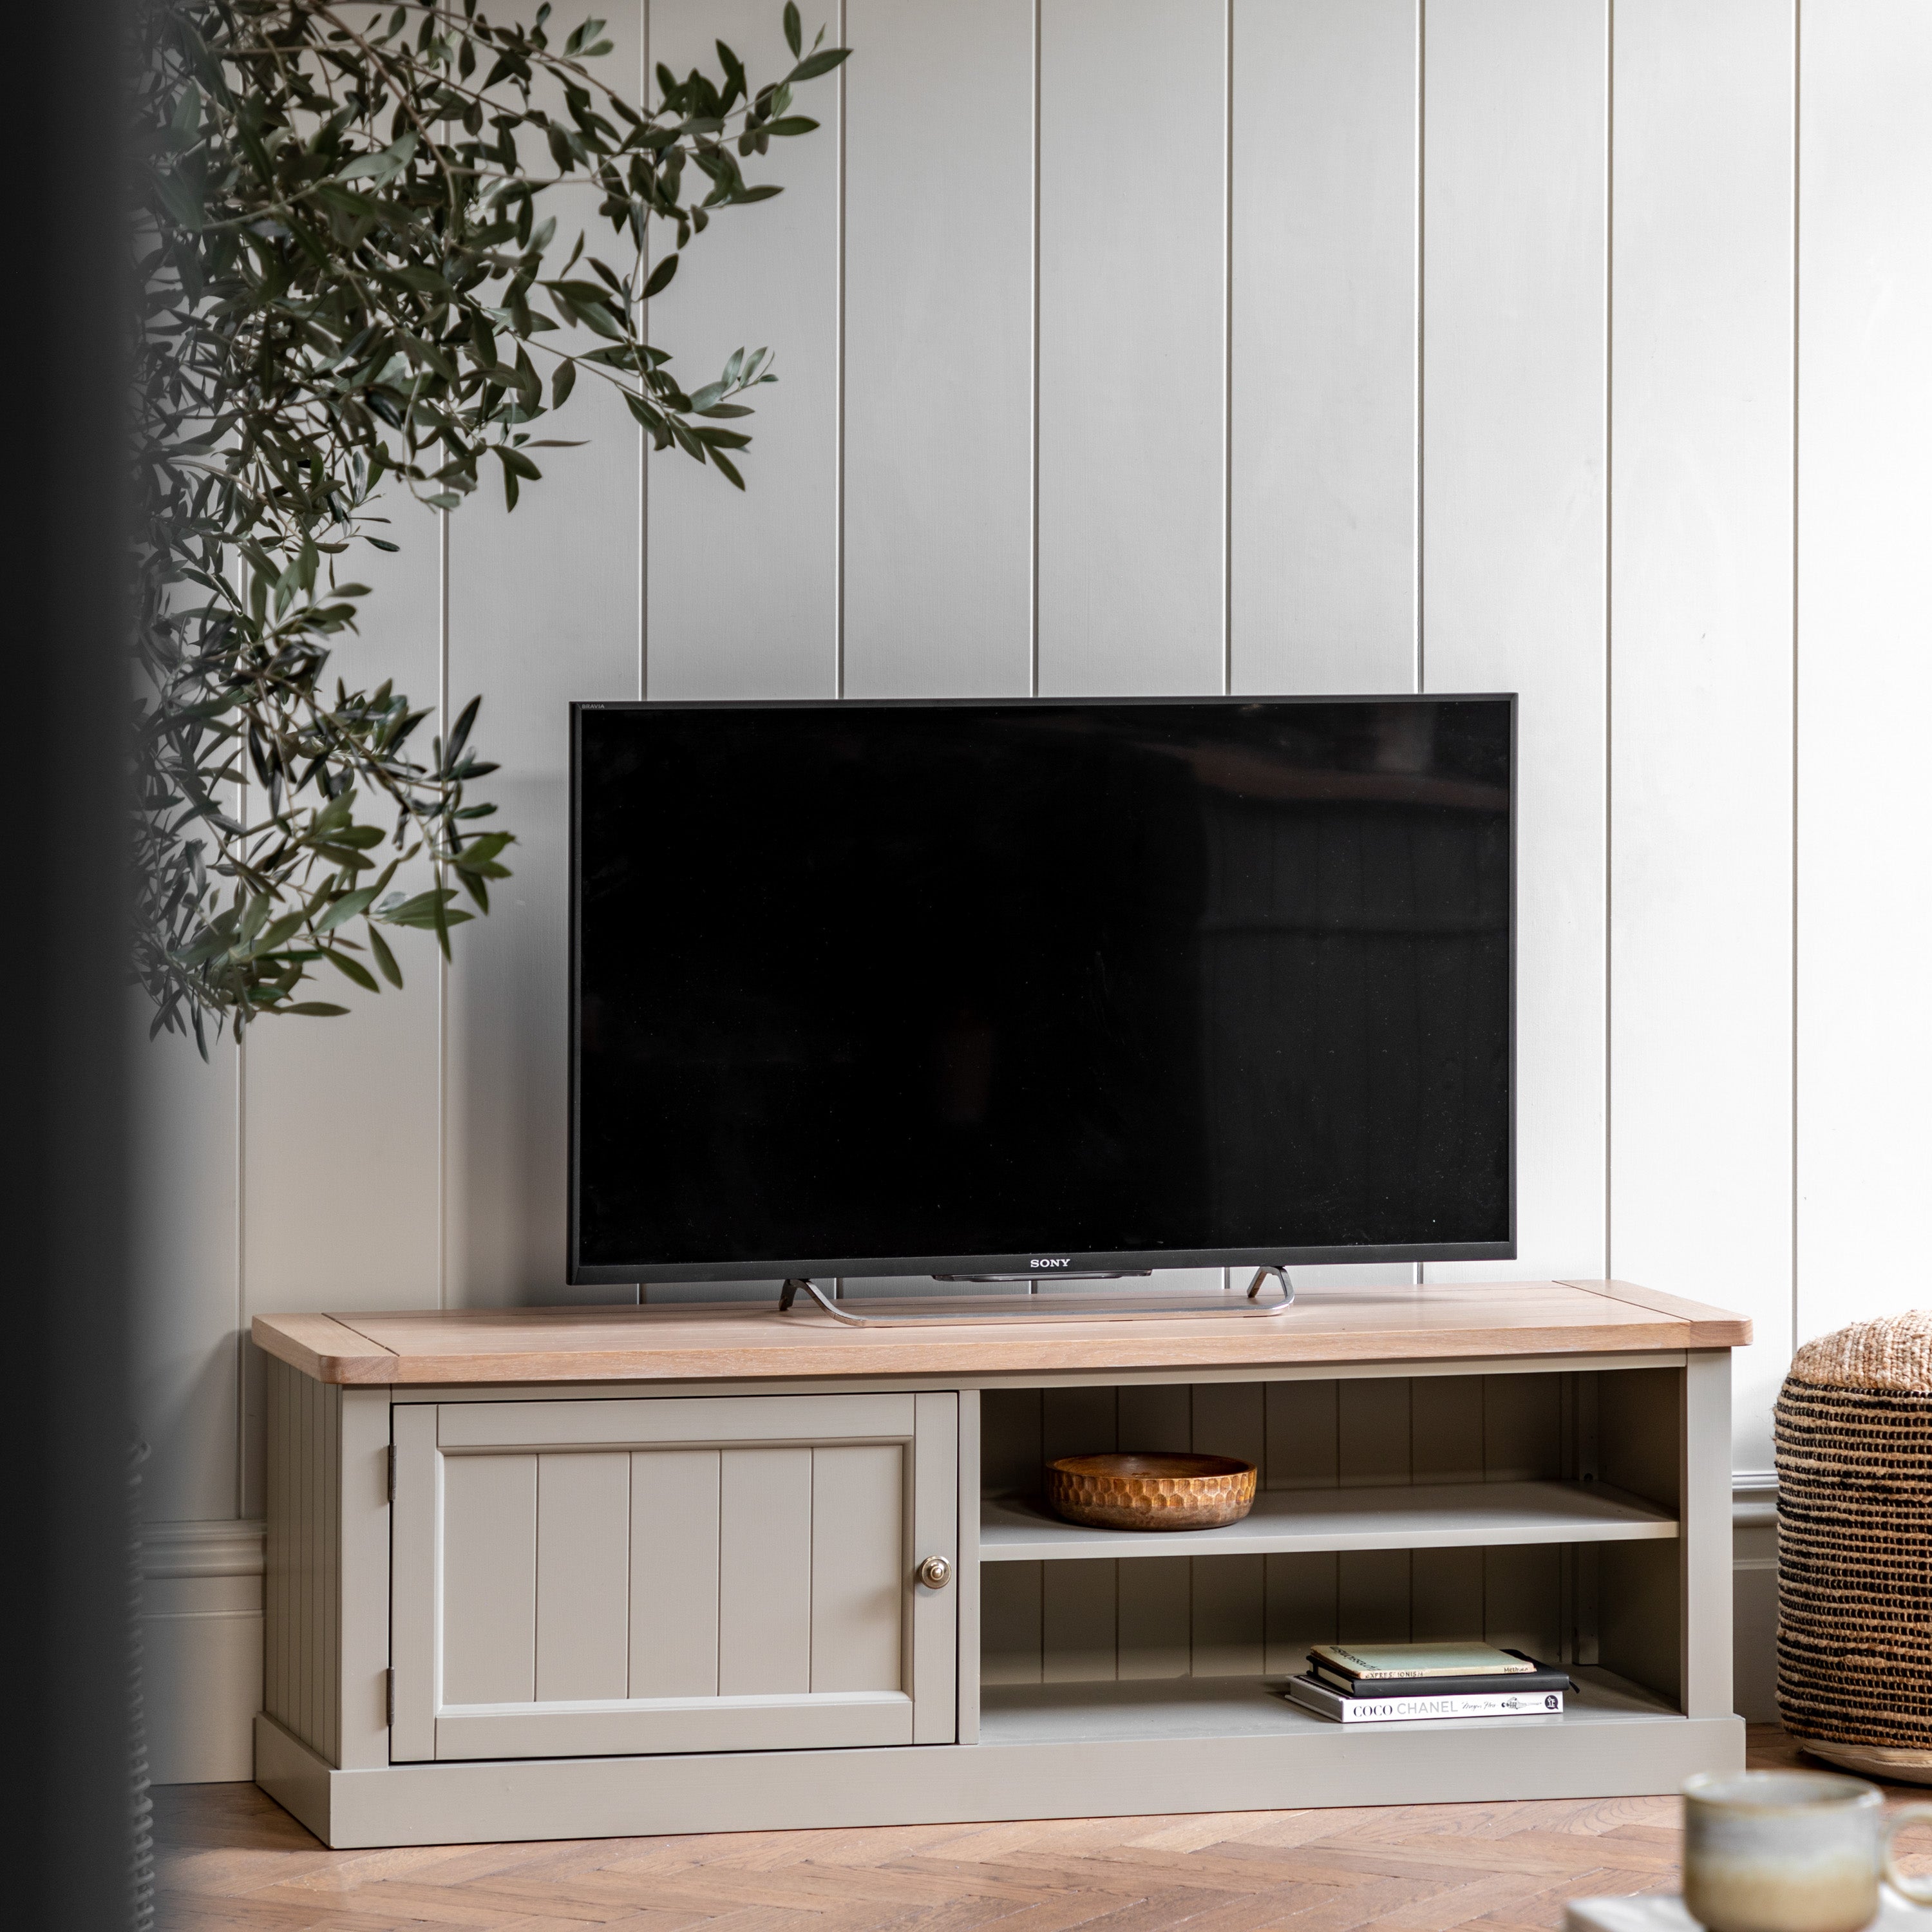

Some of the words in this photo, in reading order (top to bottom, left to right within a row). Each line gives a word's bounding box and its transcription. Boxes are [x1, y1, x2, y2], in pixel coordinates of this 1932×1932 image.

[1030, 1258, 1071, 1268] SONY
[1353, 1704, 1393, 1717] COCO
[1397, 1701, 1458, 1714] CHANEL
